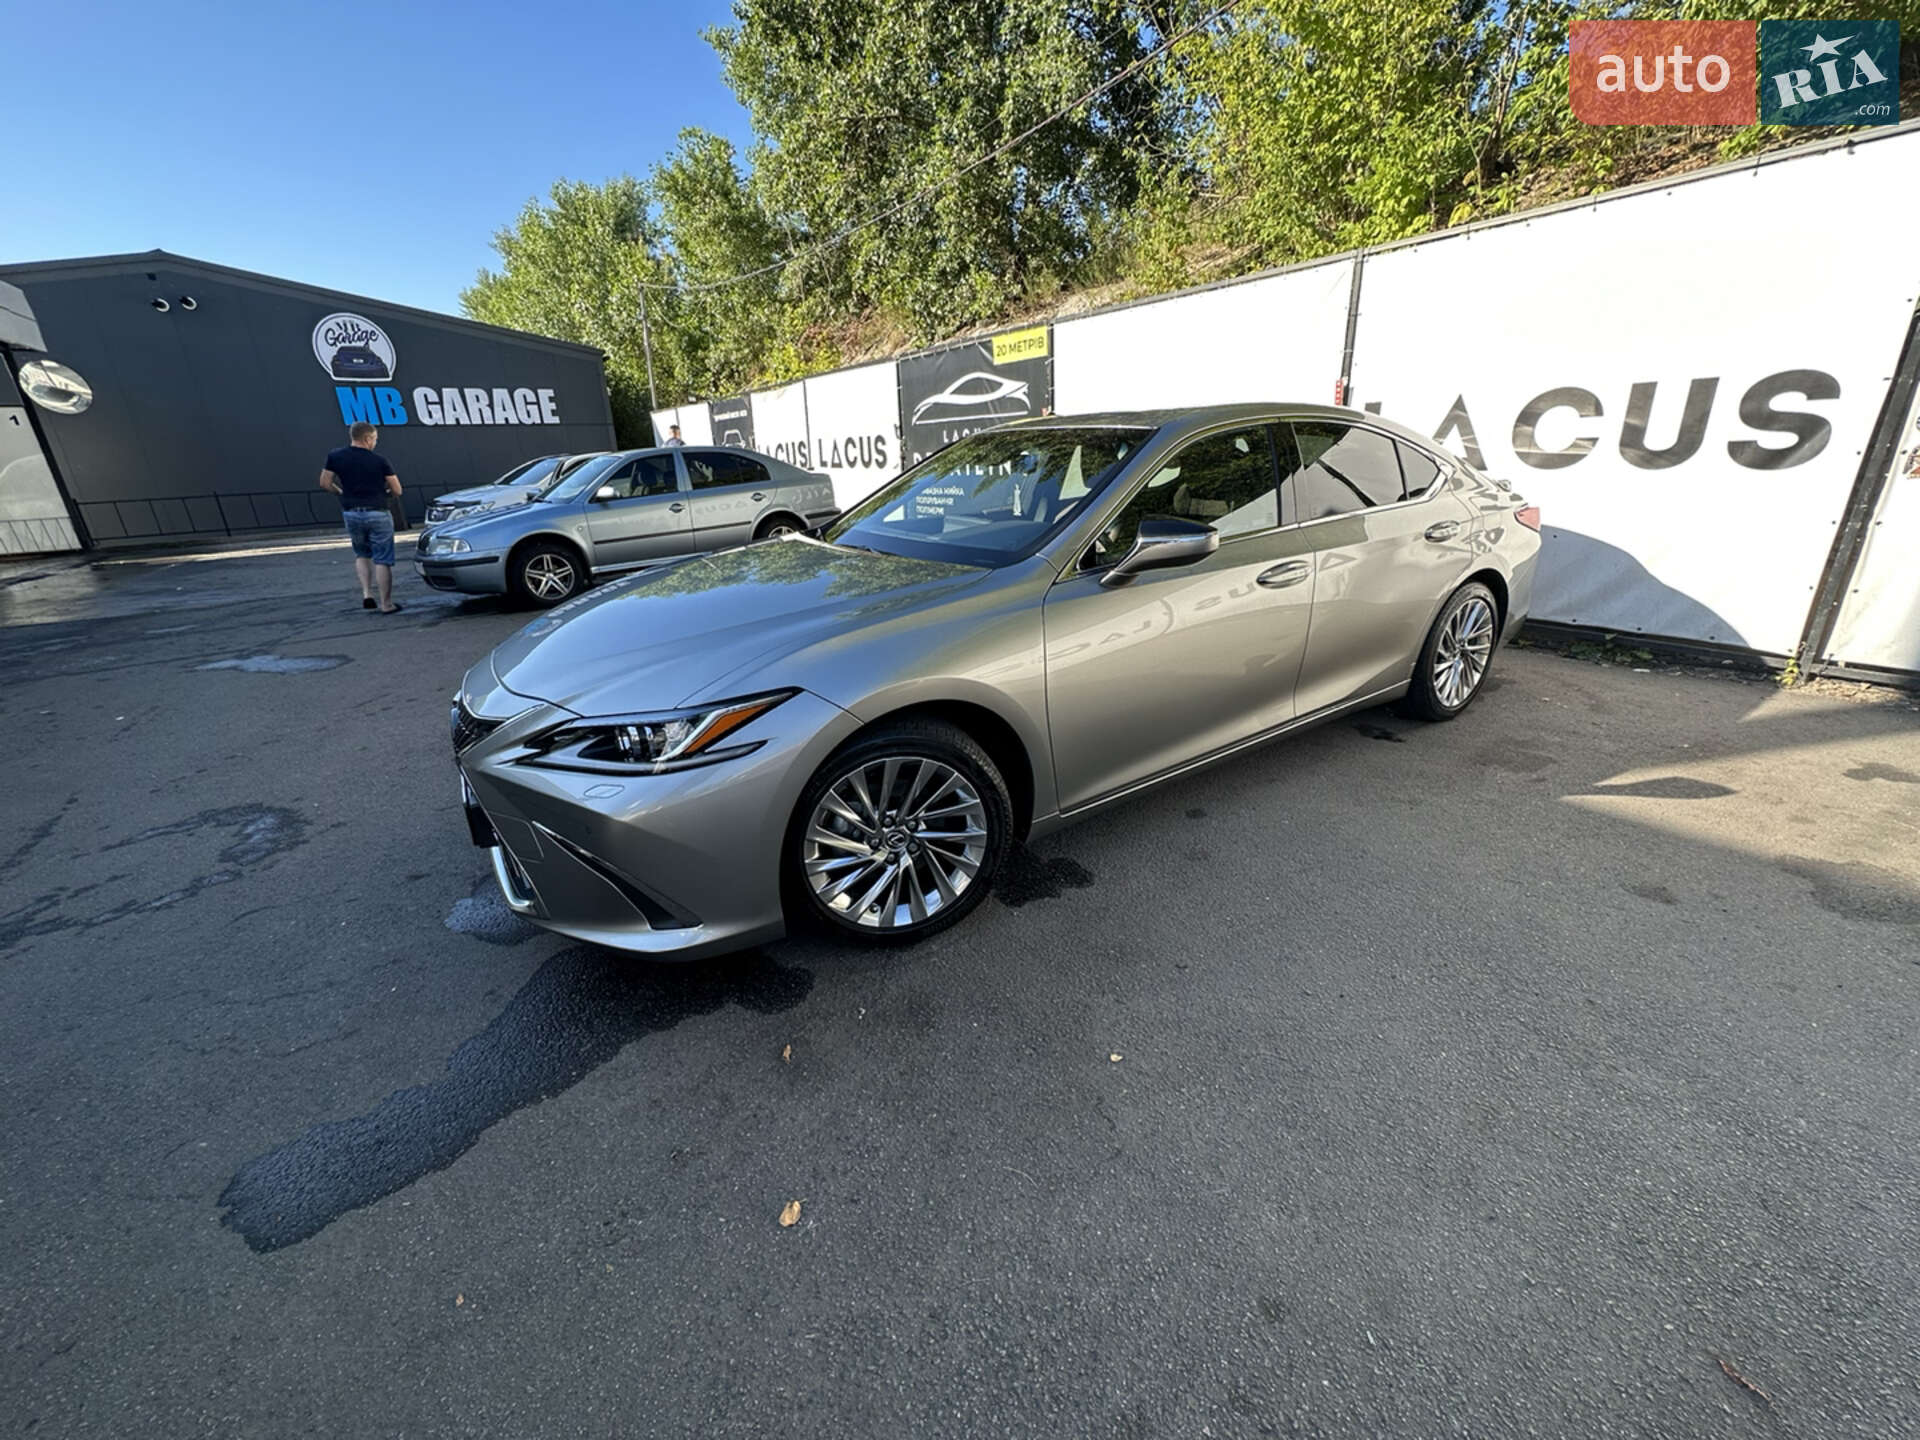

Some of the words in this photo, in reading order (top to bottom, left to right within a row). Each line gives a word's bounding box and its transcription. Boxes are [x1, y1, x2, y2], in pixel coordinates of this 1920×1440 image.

[324, 327, 379, 348] Garage
[996, 344, 1007, 357] 20
[1009, 336, 1044, 354] МЕТРІВ
[335, 386, 408, 426] MB
[412, 386, 561, 426] GARAGE
[1365, 368, 1841, 471] ACUS
[9, 414, 20, 426] 1
[757, 441, 809, 468] CUS
[818, 435, 887, 469] LACUS
